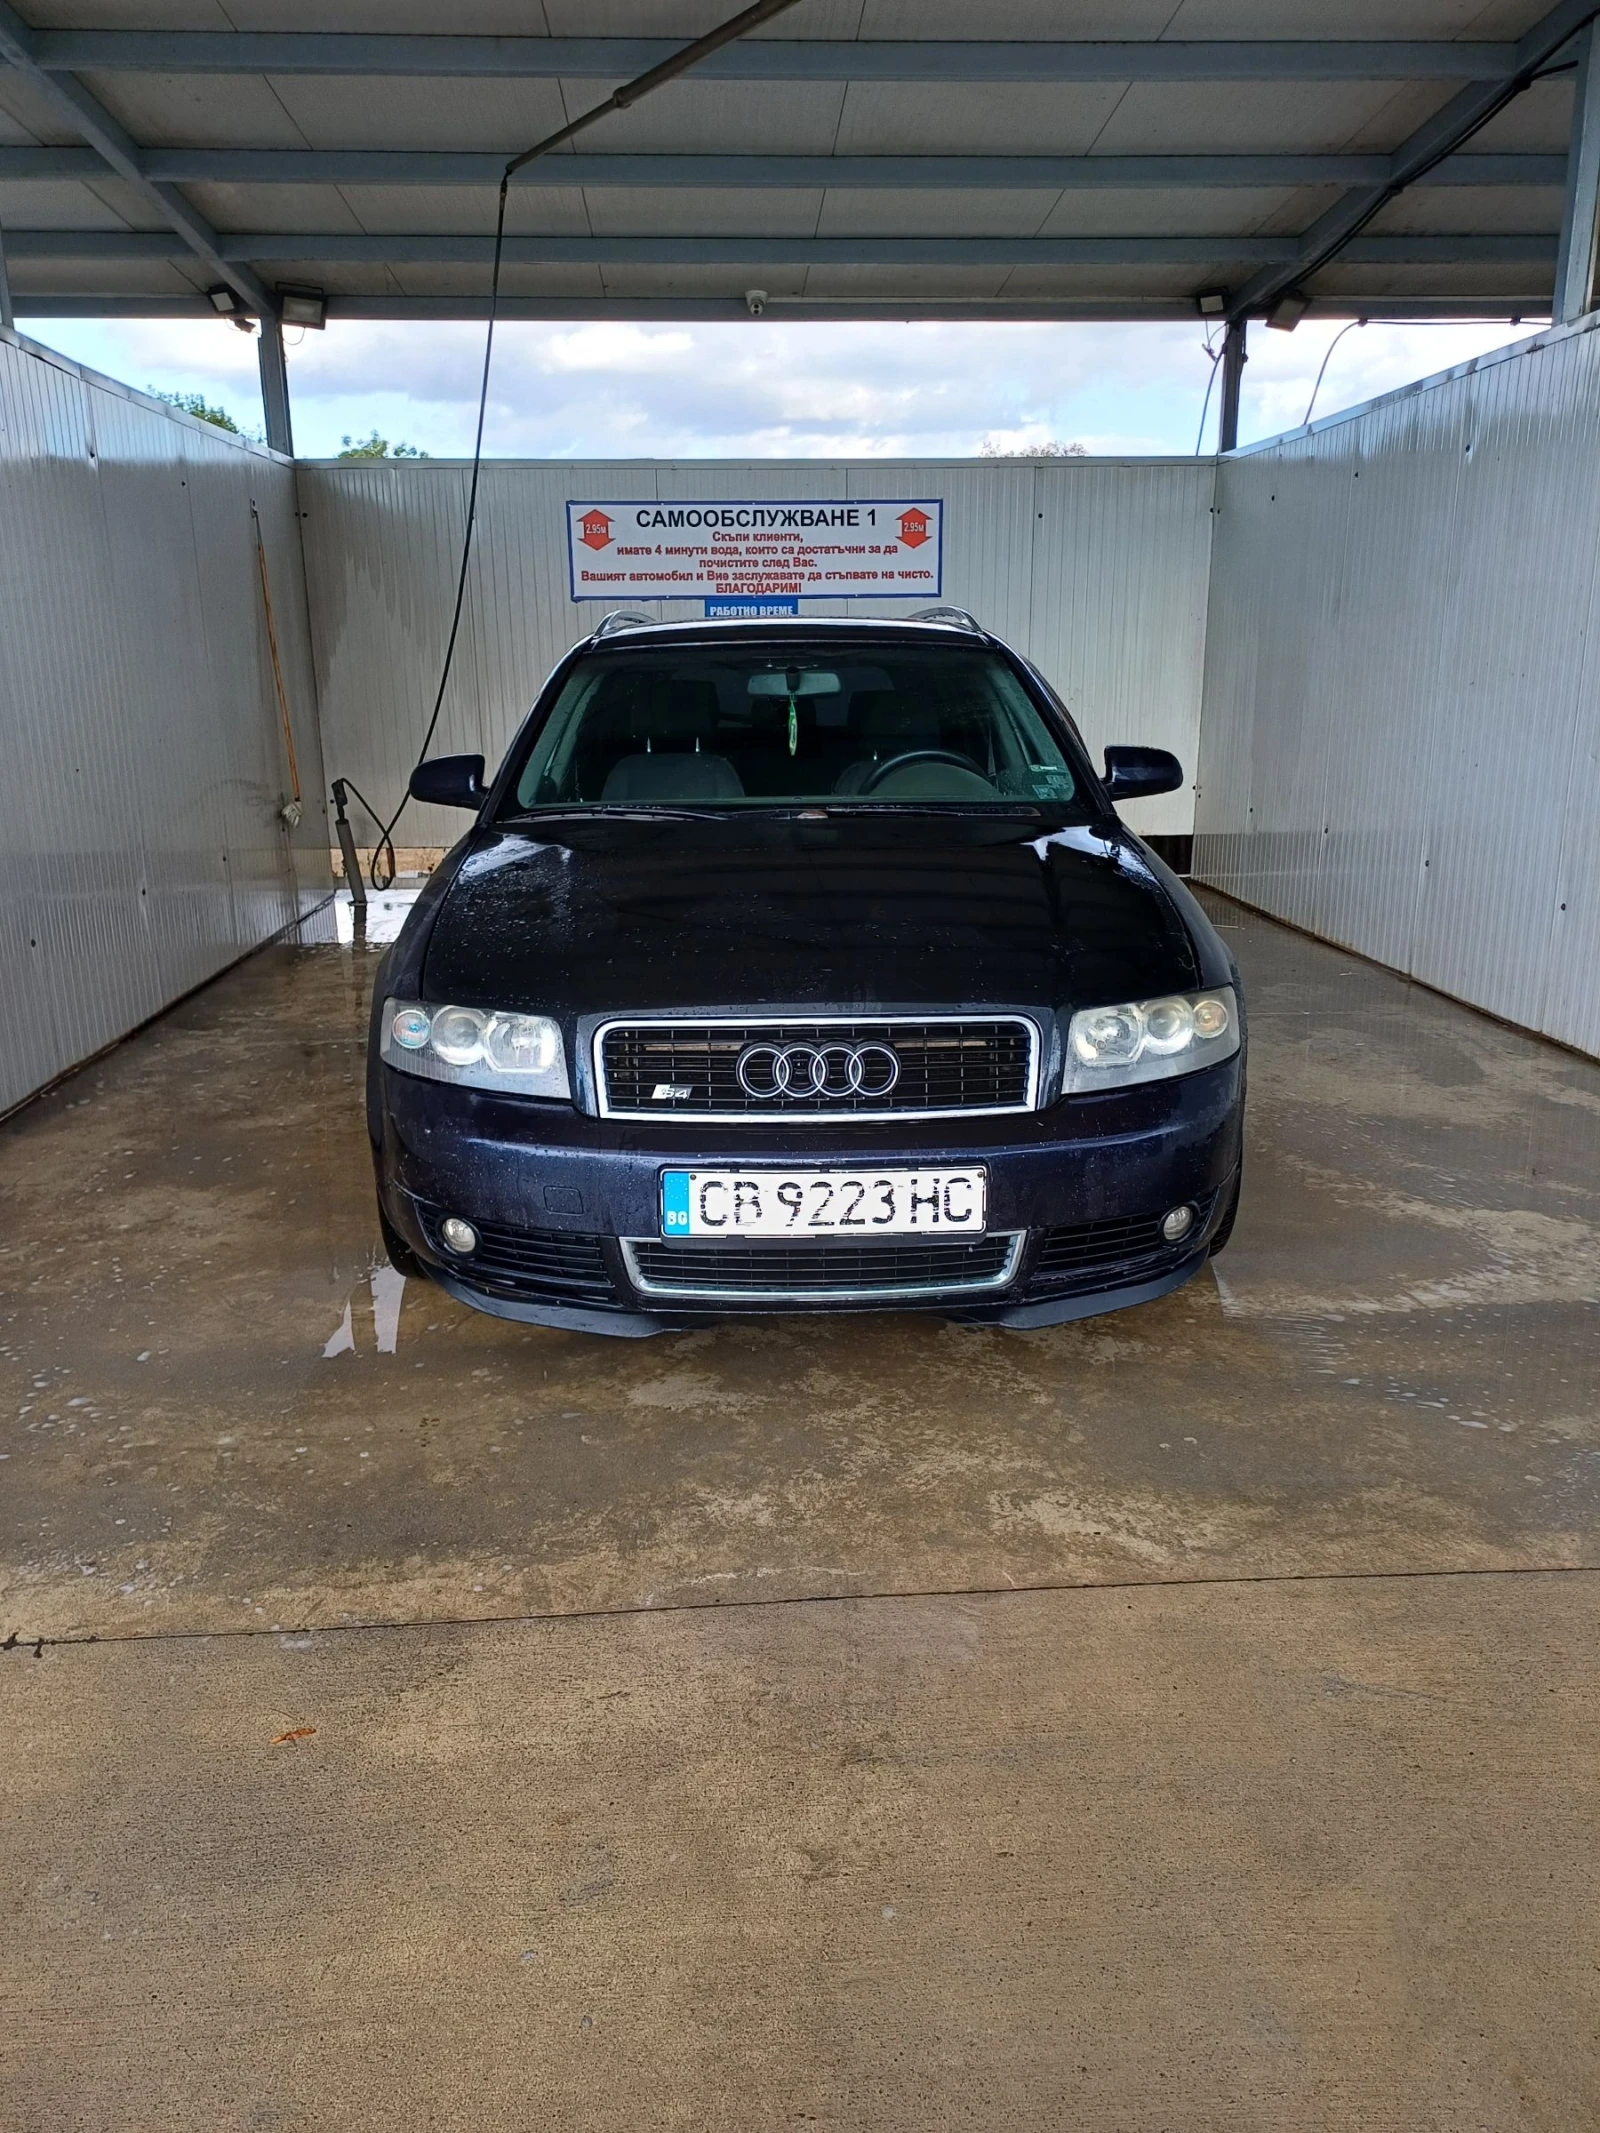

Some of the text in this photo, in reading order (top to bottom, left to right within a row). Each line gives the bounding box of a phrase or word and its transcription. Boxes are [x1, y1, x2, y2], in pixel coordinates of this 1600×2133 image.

[636, 509, 876, 527] САМООБСЛУЖВАНЕ 1
[585, 523, 607, 534] 2.95м
[903, 521, 925, 533] 2.95м
[712, 531, 804, 543] Скъпи клиенти,
[617, 544, 898, 558] имате 4 минути вода, които са достатъчни за да
[699, 557, 818, 569] почистите след Вас.
[581, 569, 934, 583] Вашият автомобил и Вие заслужавате да стъпвате на чисто.
[716, 582, 802, 594] БЛАГОДАРИМ!
[709, 605, 793, 616] РАБОТНО ВРЕМЕ
[777, 1179, 897, 1226] 9223
[910, 1177, 972, 1224] HC
[667, 1210, 688, 1226] BG
